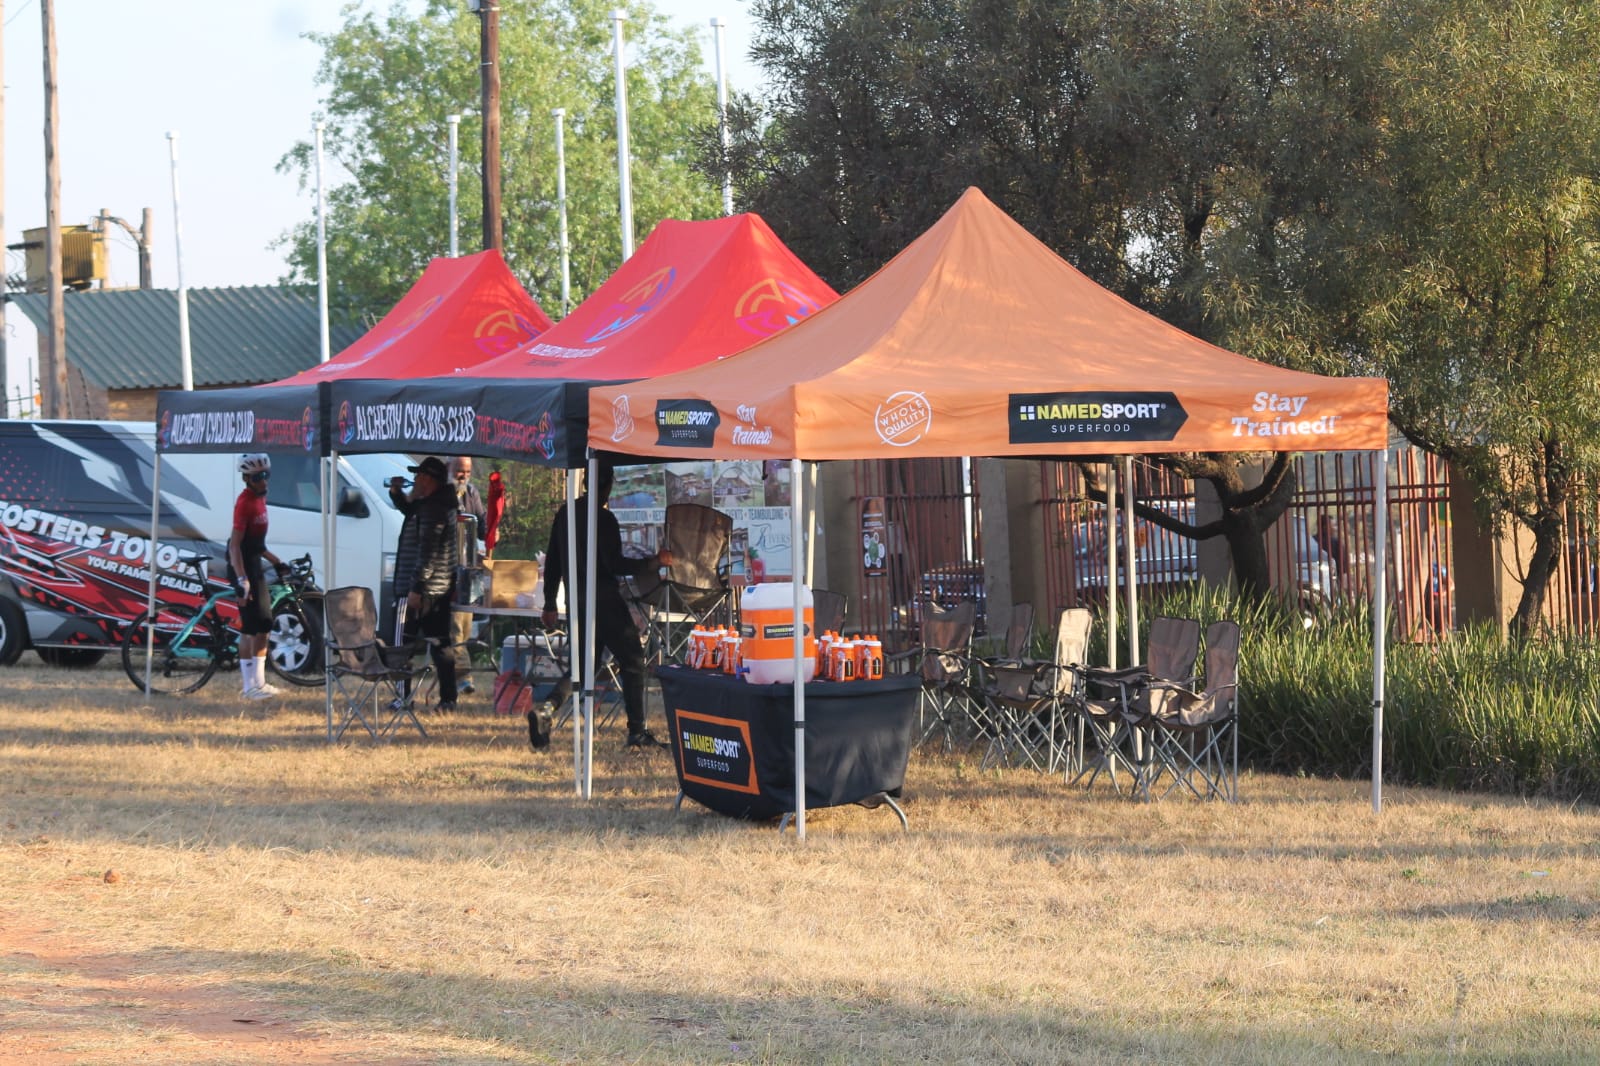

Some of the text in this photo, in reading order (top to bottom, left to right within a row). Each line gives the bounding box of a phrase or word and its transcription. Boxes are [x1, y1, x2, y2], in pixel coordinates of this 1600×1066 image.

[736, 404, 757, 426] Stay
[880, 399, 923, 427] WHOLE
[1252, 391, 1308, 417] Stay
[170, 412, 206, 445] ALCHEMY
[356, 404, 402, 441] ALCHEMY
[403, 403, 446, 442] CYCLING
[448, 406, 476, 443] CLUB
[884, 408, 926, 436] QUALITY
[1051, 424, 1131, 433] SUPERFOOD
[87, 555, 119, 573] YOUR
[696, 757, 730, 773] SUPERFOOD
